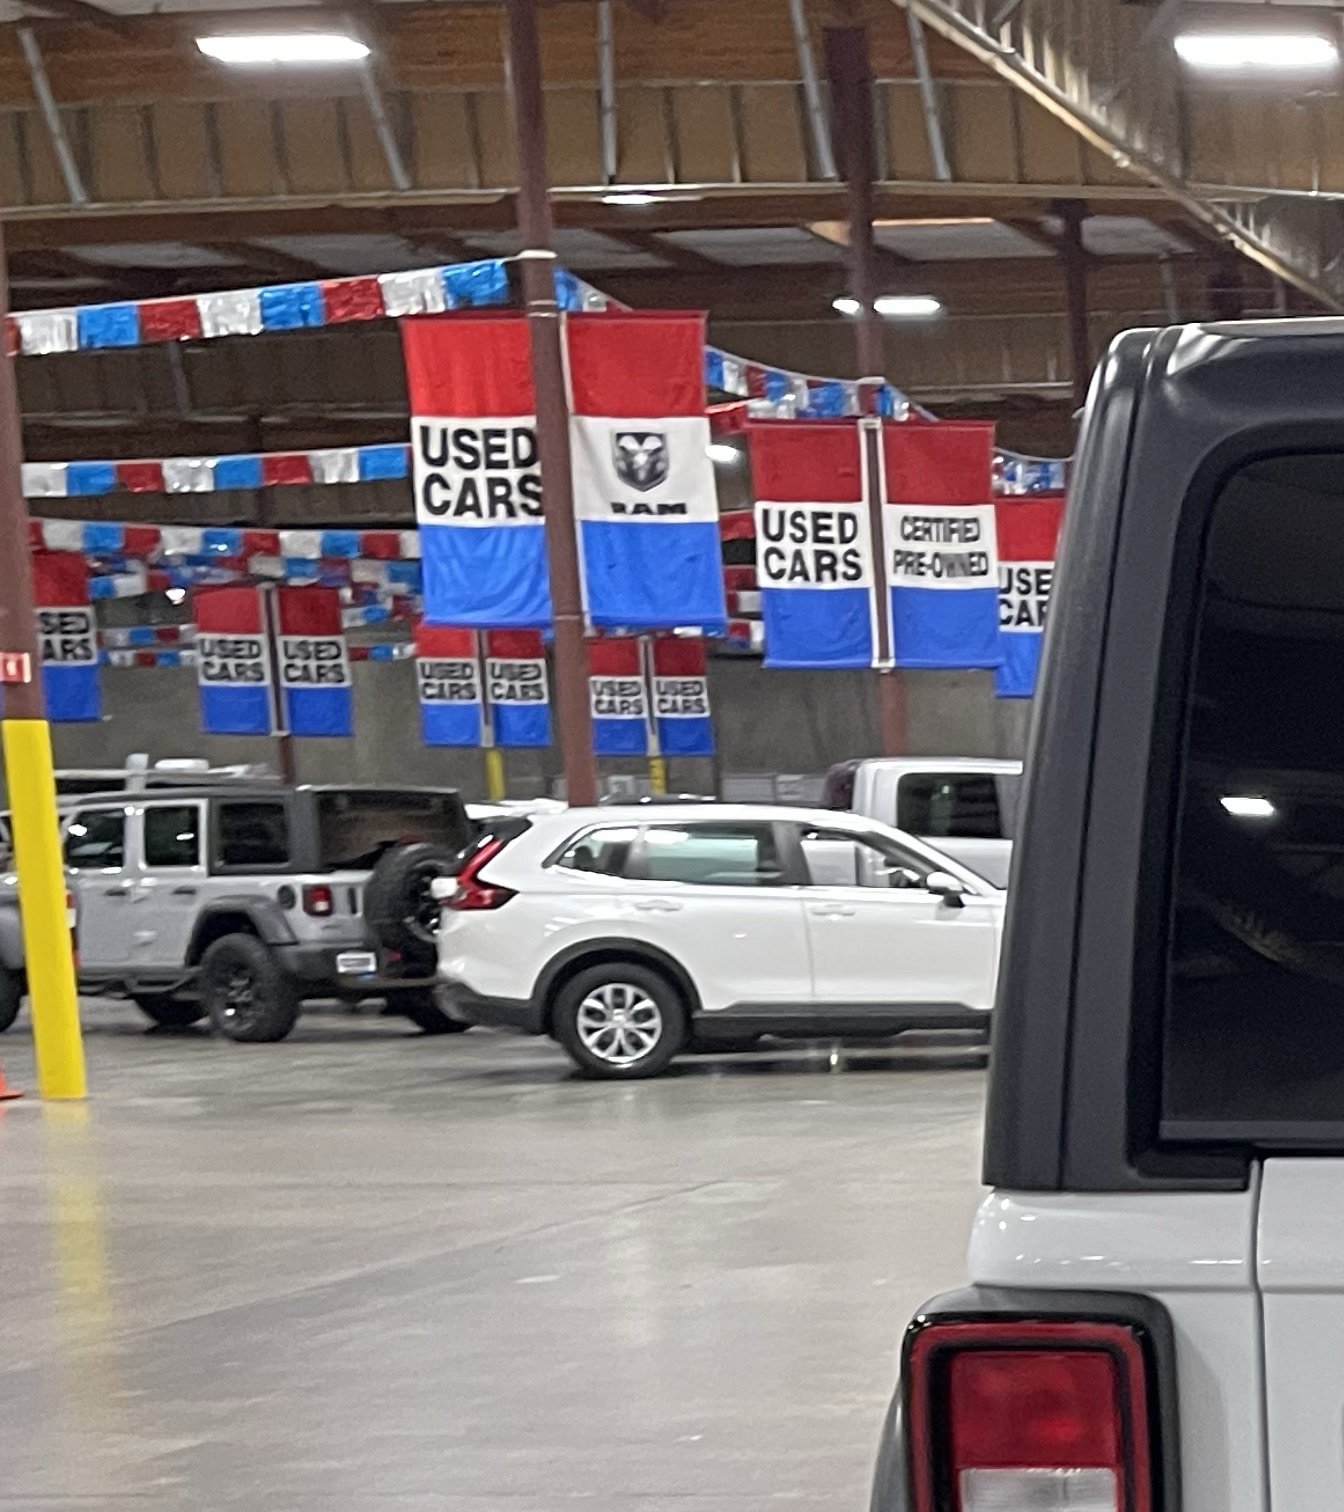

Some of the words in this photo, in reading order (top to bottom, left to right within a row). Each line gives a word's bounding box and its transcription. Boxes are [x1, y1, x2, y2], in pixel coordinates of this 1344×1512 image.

[419, 425, 539, 470] USED
[423, 473, 542, 518] CARS
[610, 502, 687, 515] RAM
[761, 509, 859, 544] USED
[901, 514, 981, 543] CERTIFIED
[763, 546, 863, 582] CARS
[893, 549, 989, 578] PRE-OWNED
[998, 567, 1052, 596] USE
[38, 611, 91, 635] SED
[42, 638, 93, 662] ARS
[201, 638, 262, 659] USED
[283, 639, 342, 661] USED
[203, 660, 266, 682] CARS
[284, 662, 346, 684] CARS
[421, 661, 474, 680] USED
[491, 662, 543, 681] USED
[421, 681, 477, 700] CARS
[491, 681, 546, 700] CARS
[591, 680, 642, 697] USED
[656, 680, 704, 696] USED
[594, 698, 643, 715] CARS
[657, 697, 706, 714] CARS
